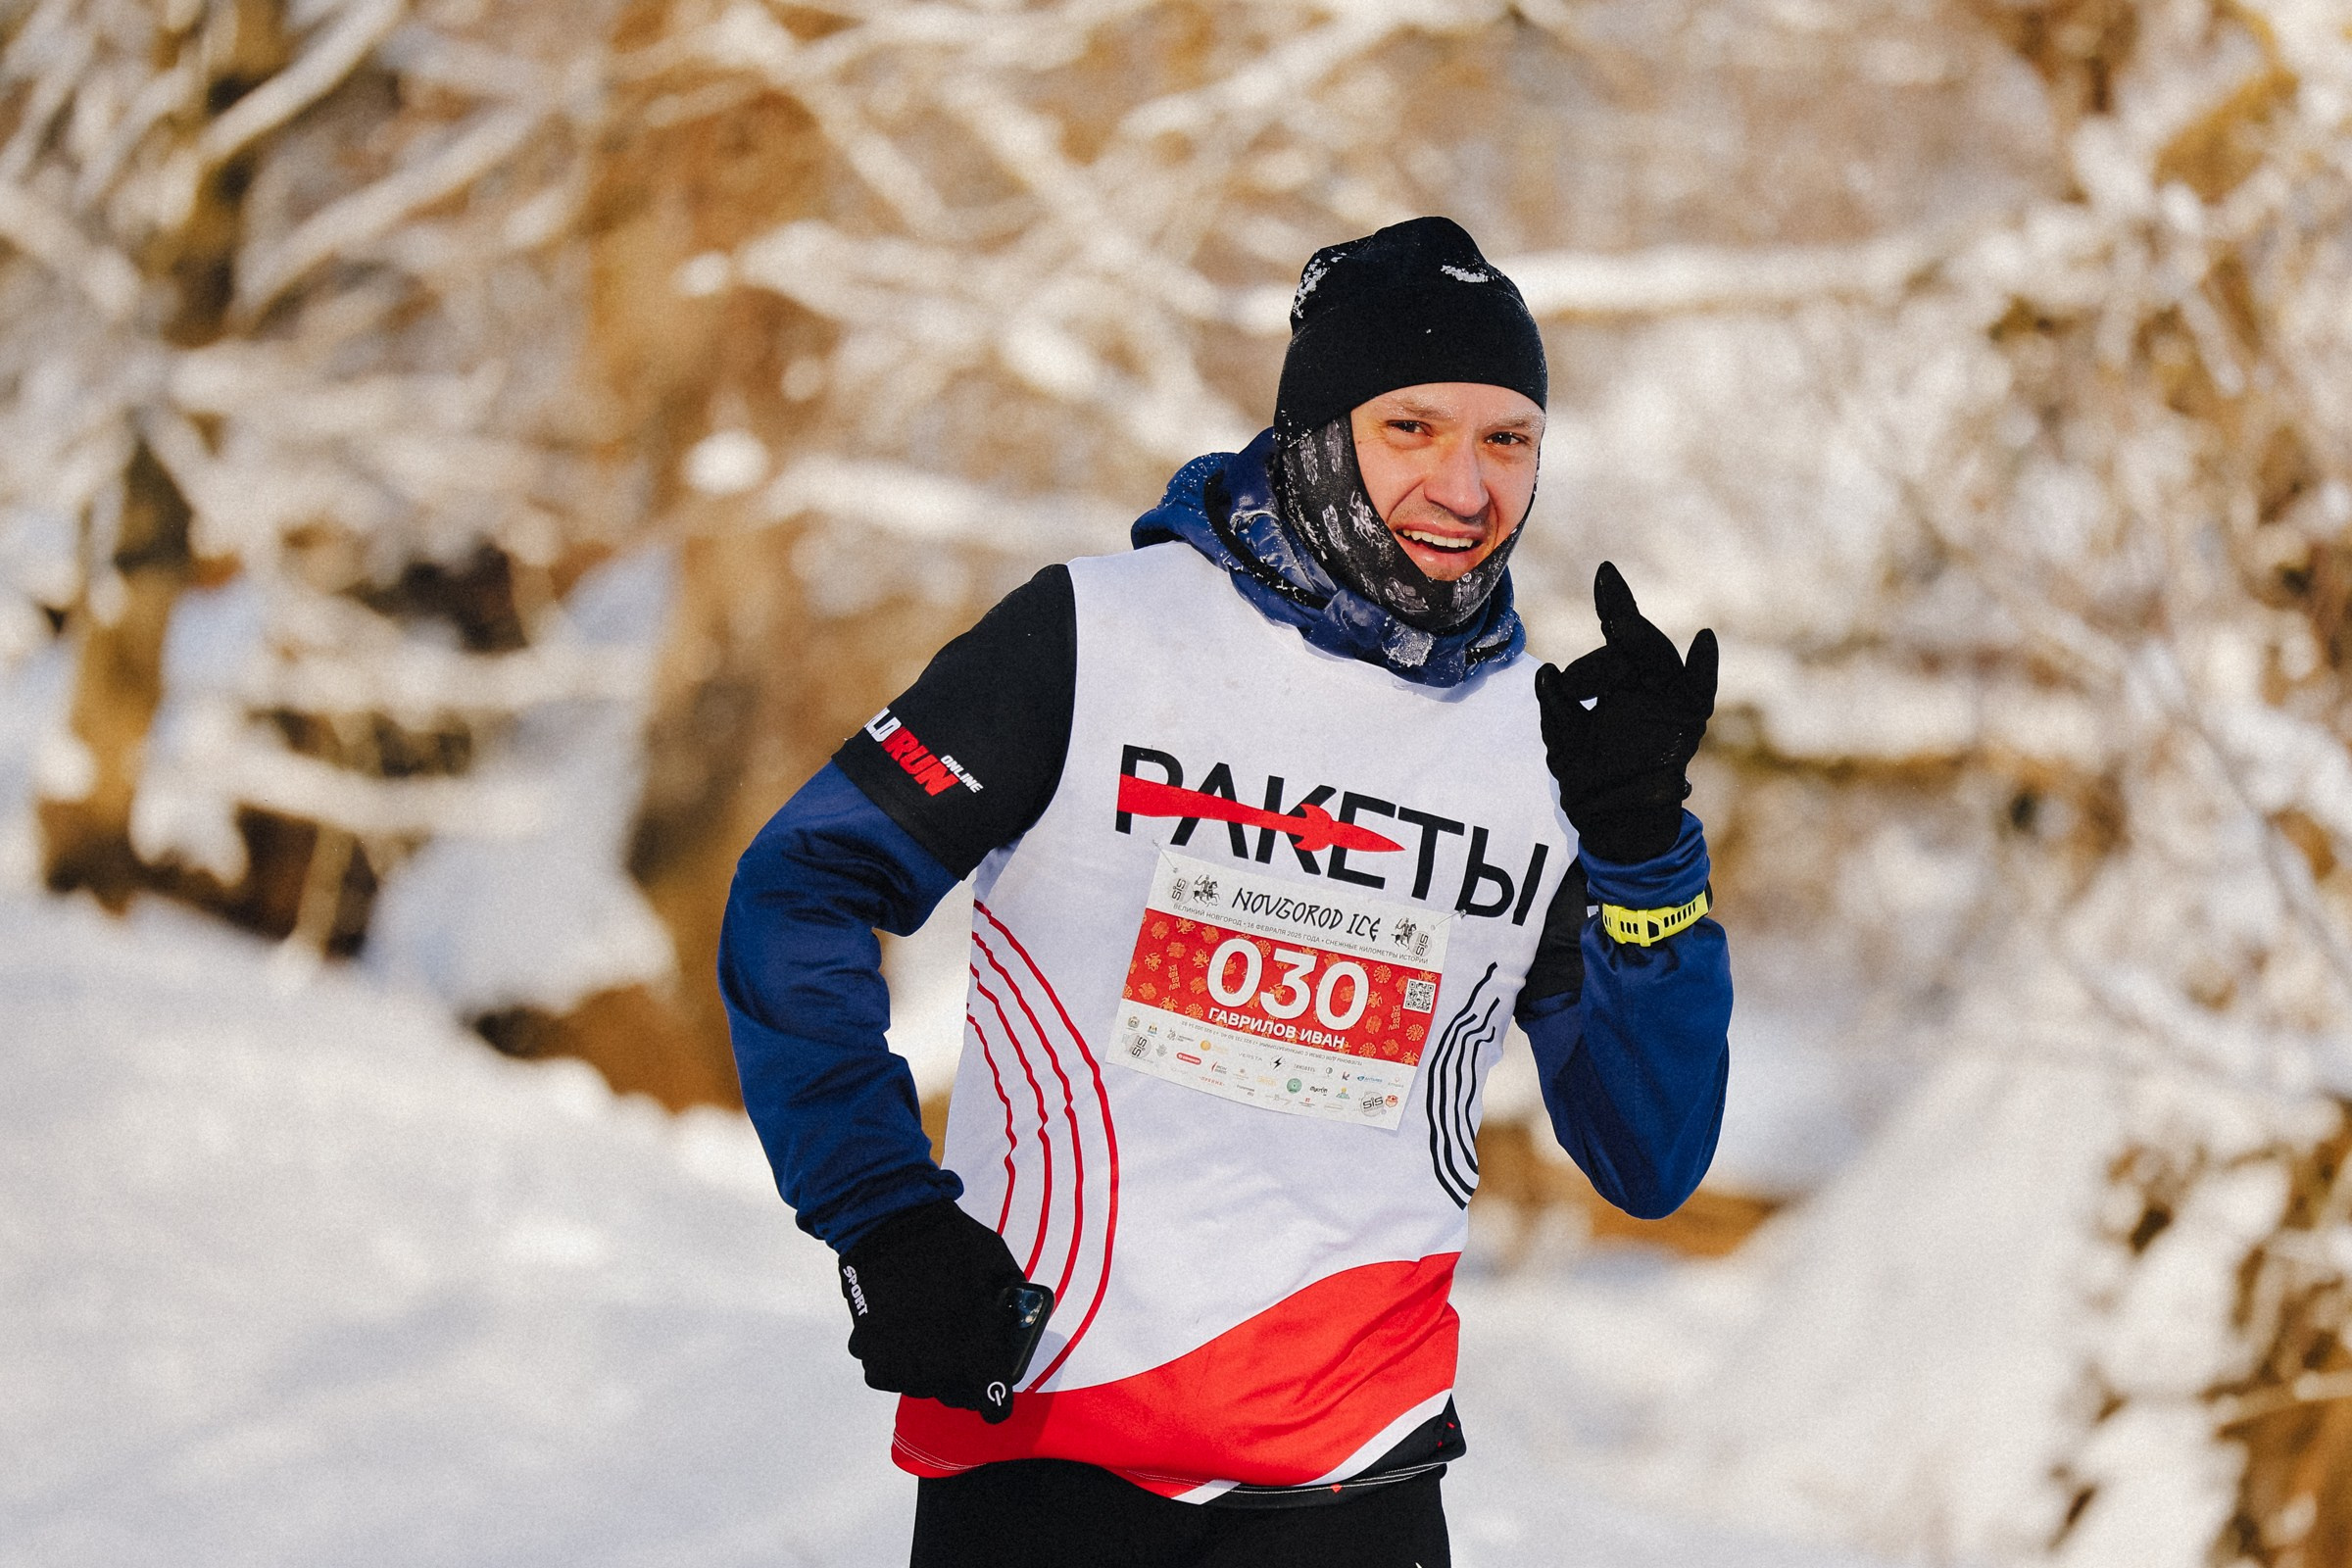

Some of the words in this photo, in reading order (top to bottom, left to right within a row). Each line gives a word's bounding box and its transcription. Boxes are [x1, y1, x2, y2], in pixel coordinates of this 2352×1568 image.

[941, 755, 984, 794] ONLINE
[1115, 744, 1549, 927] РАКЕТЫ
[1172, 904, 1204, 915] ВЕЛИКИЙ
[1206, 912, 1242, 926] НОВГОРОД
[1256, 924, 1286, 935] ФЕВРАЛЯ
[1303, 933, 1319, 943] ГОДА
[1325, 939, 1358, 951] СНЕЖНЫЕ
[1359, 947, 1397, 958] КИЛОМЕТРЫ
[1399, 953, 1429, 964] ИСТОРИИ
[1231, 888, 1343, 929] NOVGOROD
[1347, 913, 1381, 942] ICE
[1207, 938, 1370, 1031] 030
[1207, 1007, 1297, 1039] ГАВРИЛОВ
[1299, 1029, 1346, 1049] ИВАН
[843, 1265, 868, 1316] SPORT
